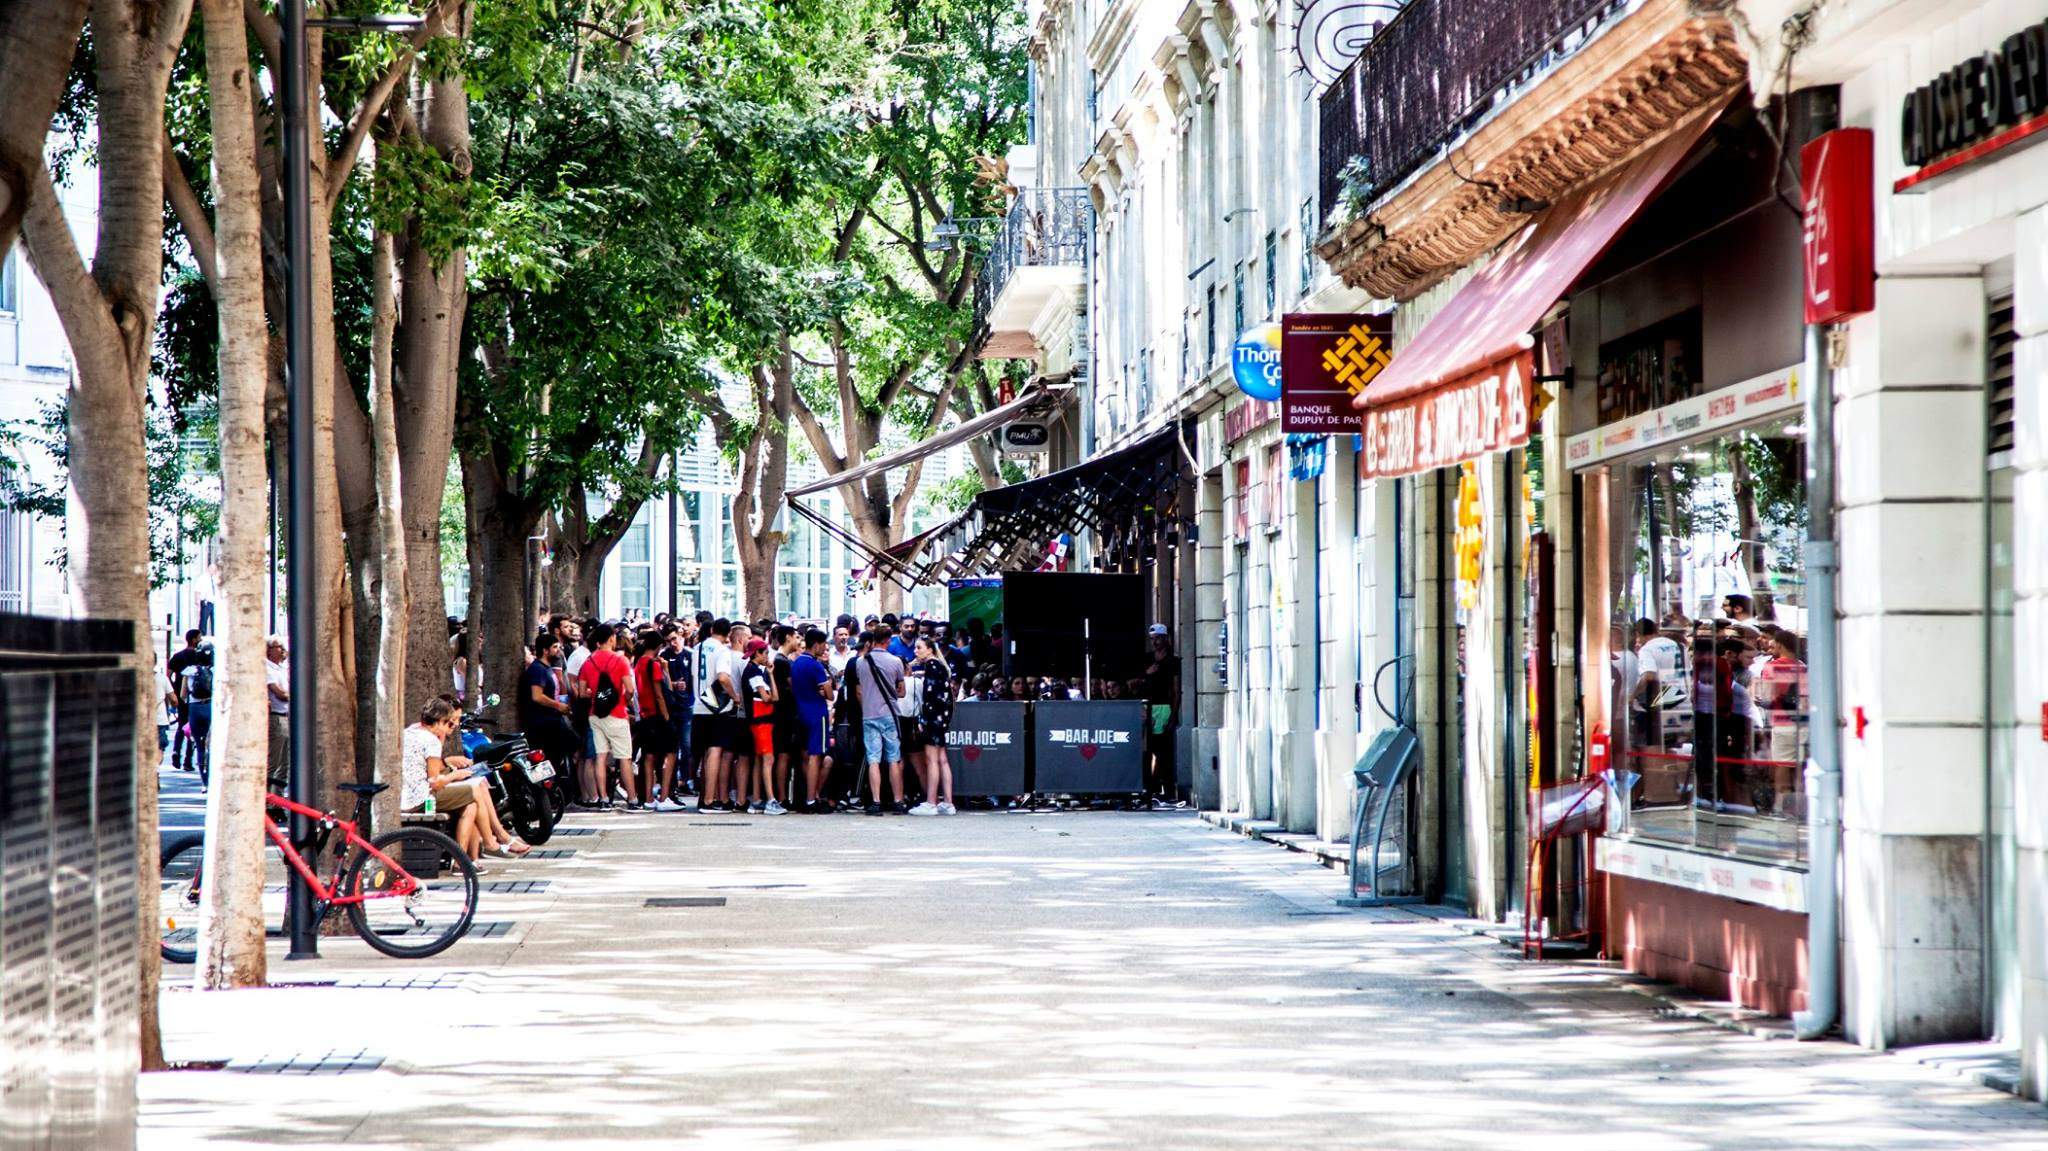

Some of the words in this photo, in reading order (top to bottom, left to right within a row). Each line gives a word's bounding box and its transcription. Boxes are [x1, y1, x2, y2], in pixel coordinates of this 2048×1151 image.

[1902, 56, 1977, 167] CAISSE
[1290, 405, 1332, 415] BANQUE
[1327, 416, 1341, 424] DE
[1009, 431, 1031, 440] PMU
[950, 730, 973, 745] BAR
[974, 730, 996, 745] JOE
[1065, 729, 1089, 744] BAR
[1090, 729, 1114, 744] JOE
